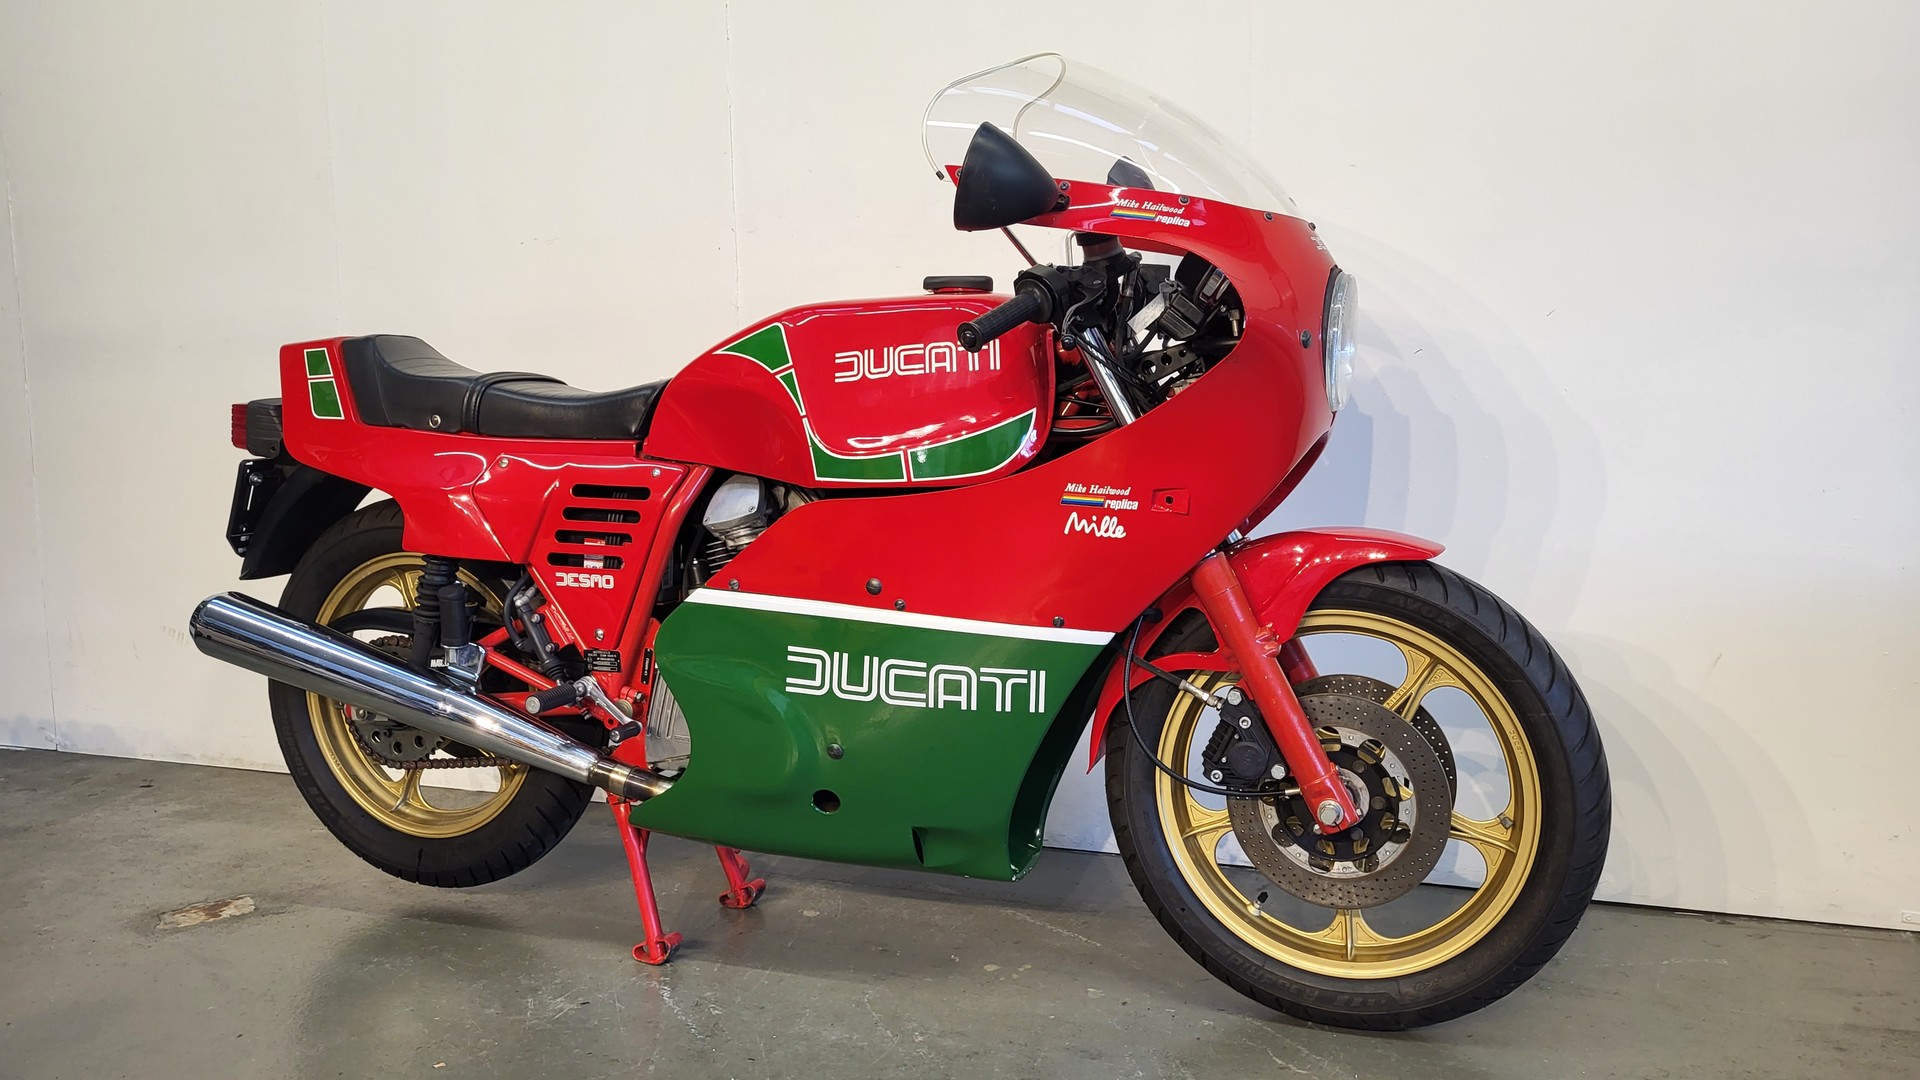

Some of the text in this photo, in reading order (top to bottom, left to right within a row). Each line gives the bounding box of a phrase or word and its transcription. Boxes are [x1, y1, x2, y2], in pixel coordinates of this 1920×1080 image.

[1116, 199, 1185, 214] Mike Hailwood
[1155, 215, 1191, 227] replica
[834, 338, 1001, 383] DUCATI
[1064, 483, 1131, 496] Mike Hailwood
[1104, 499, 1139, 511] replica
[1064, 511, 1127, 538] Mille
[555, 572, 615, 589] DESMO
[785, 645, 1046, 713] DUCATI
